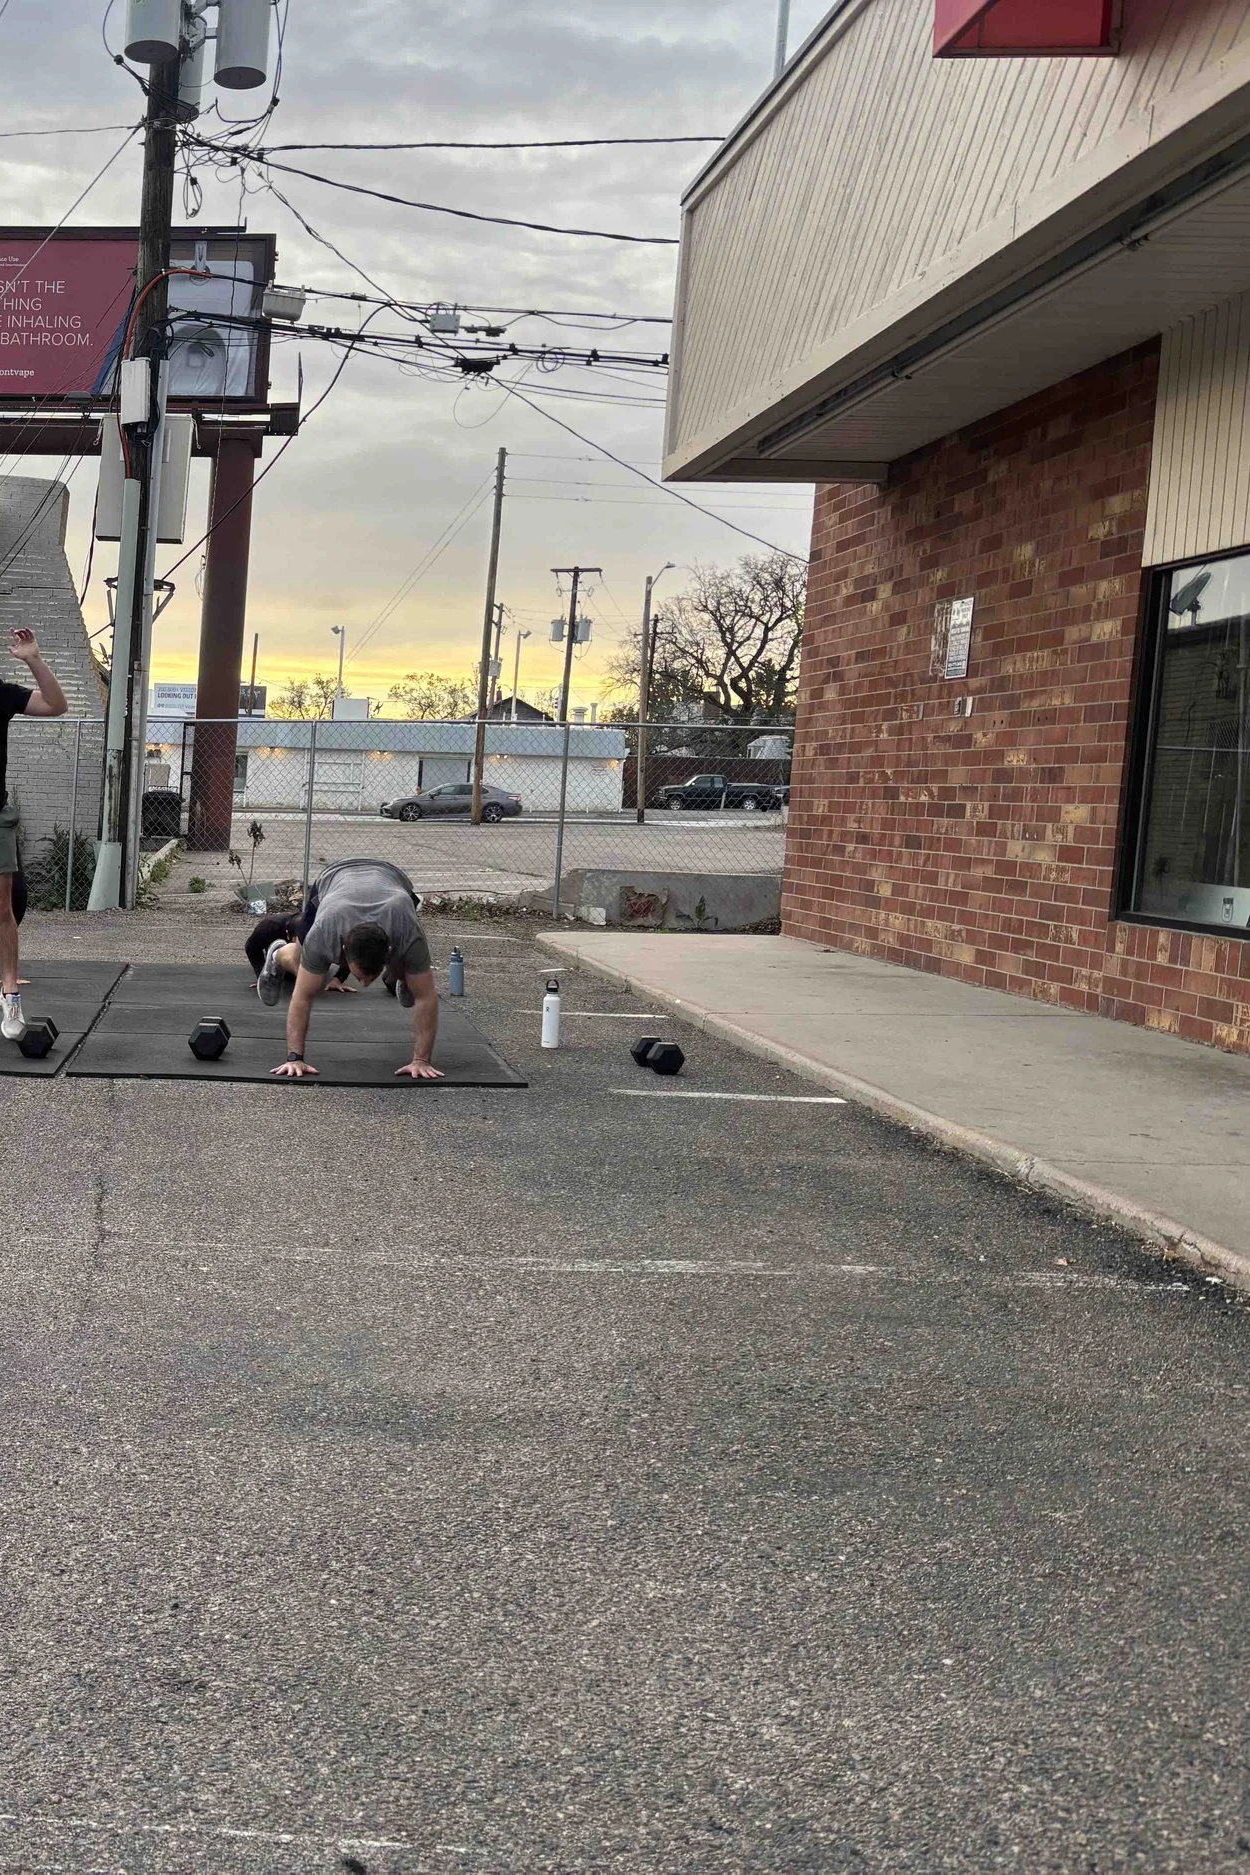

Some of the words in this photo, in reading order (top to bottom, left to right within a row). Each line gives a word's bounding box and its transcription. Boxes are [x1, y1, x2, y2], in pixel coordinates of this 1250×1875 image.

[35, 280, 66, 294] THE
[7, 314, 82, 330] INHALING
[0, 332, 94, 347] BATHROOM.
